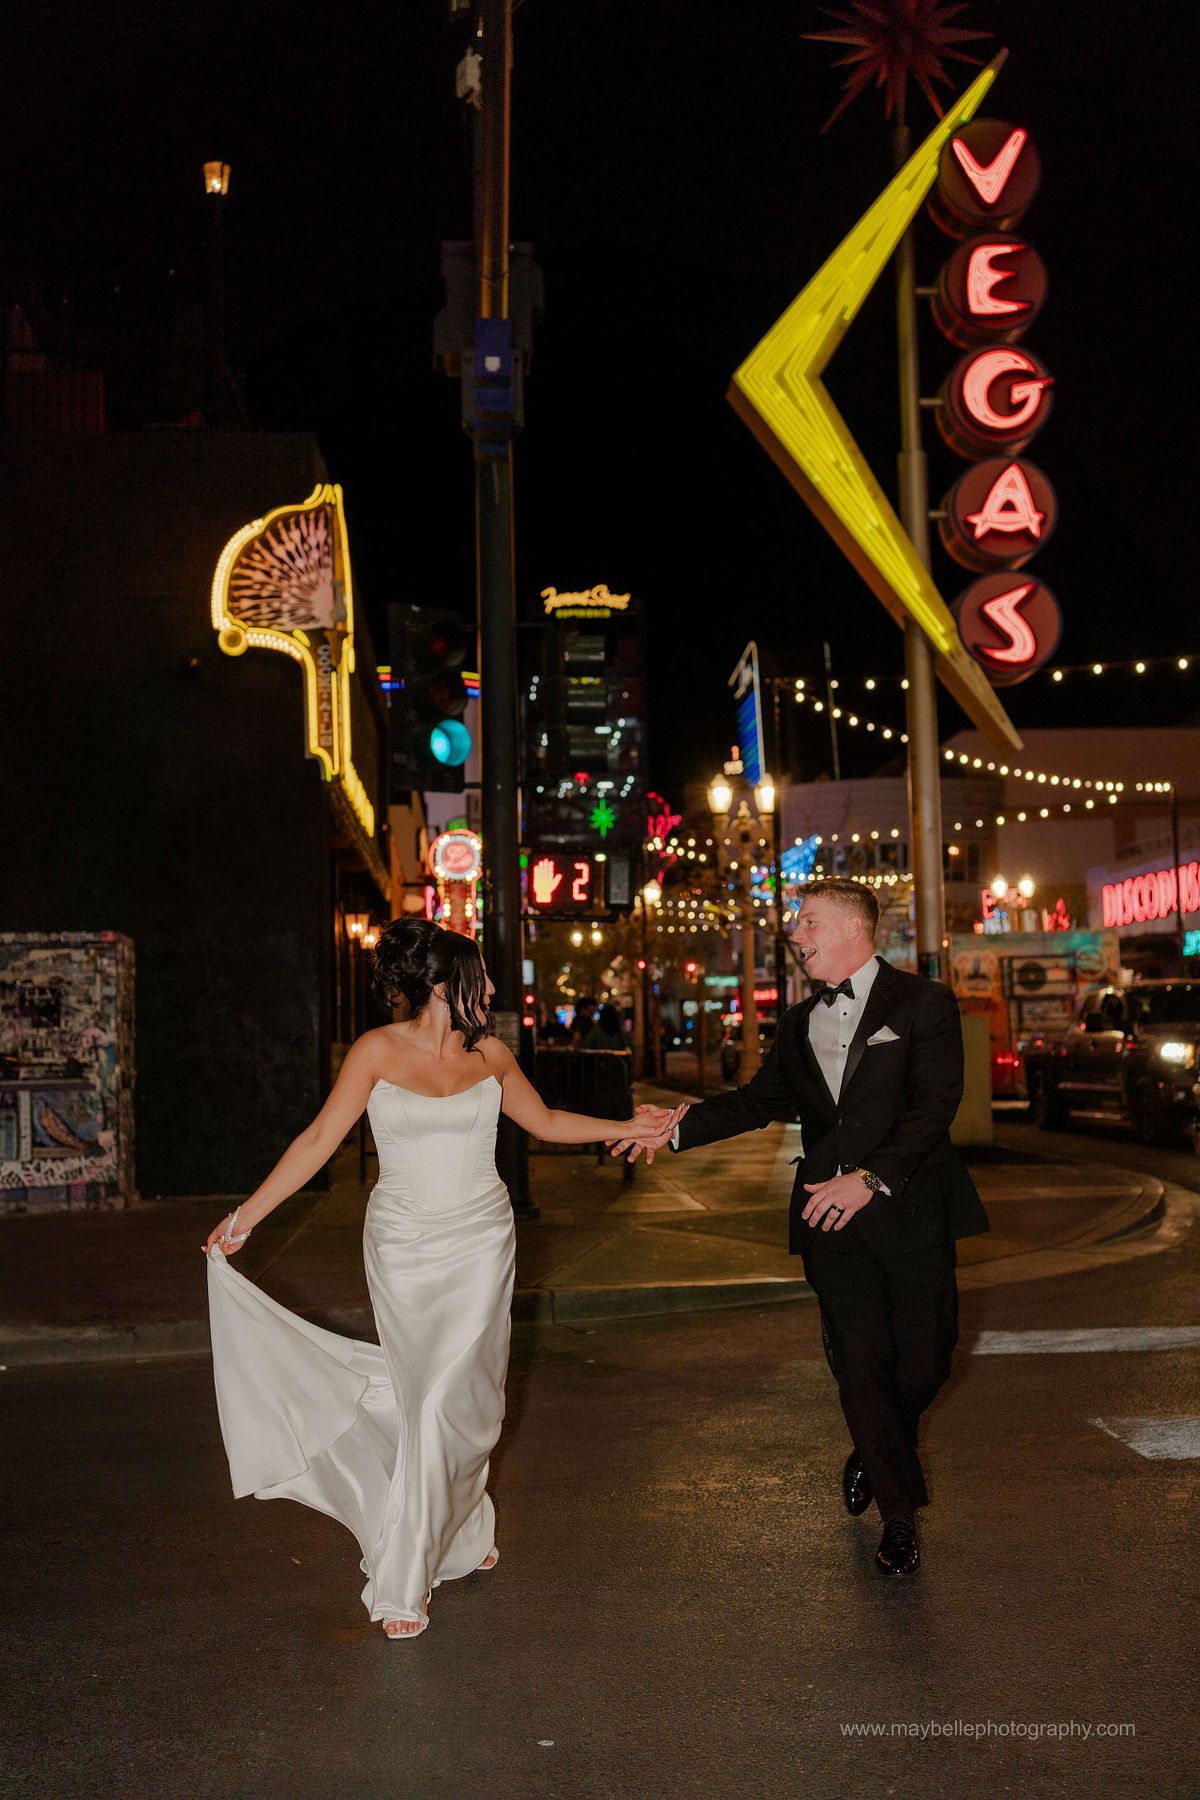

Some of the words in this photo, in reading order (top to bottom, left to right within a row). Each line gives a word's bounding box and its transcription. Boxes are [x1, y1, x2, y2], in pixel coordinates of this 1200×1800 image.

[951, 127, 1054, 664] VEGAS
[572, 862, 590, 901] 2
[1102, 861, 1200, 928] DISCOPUS
